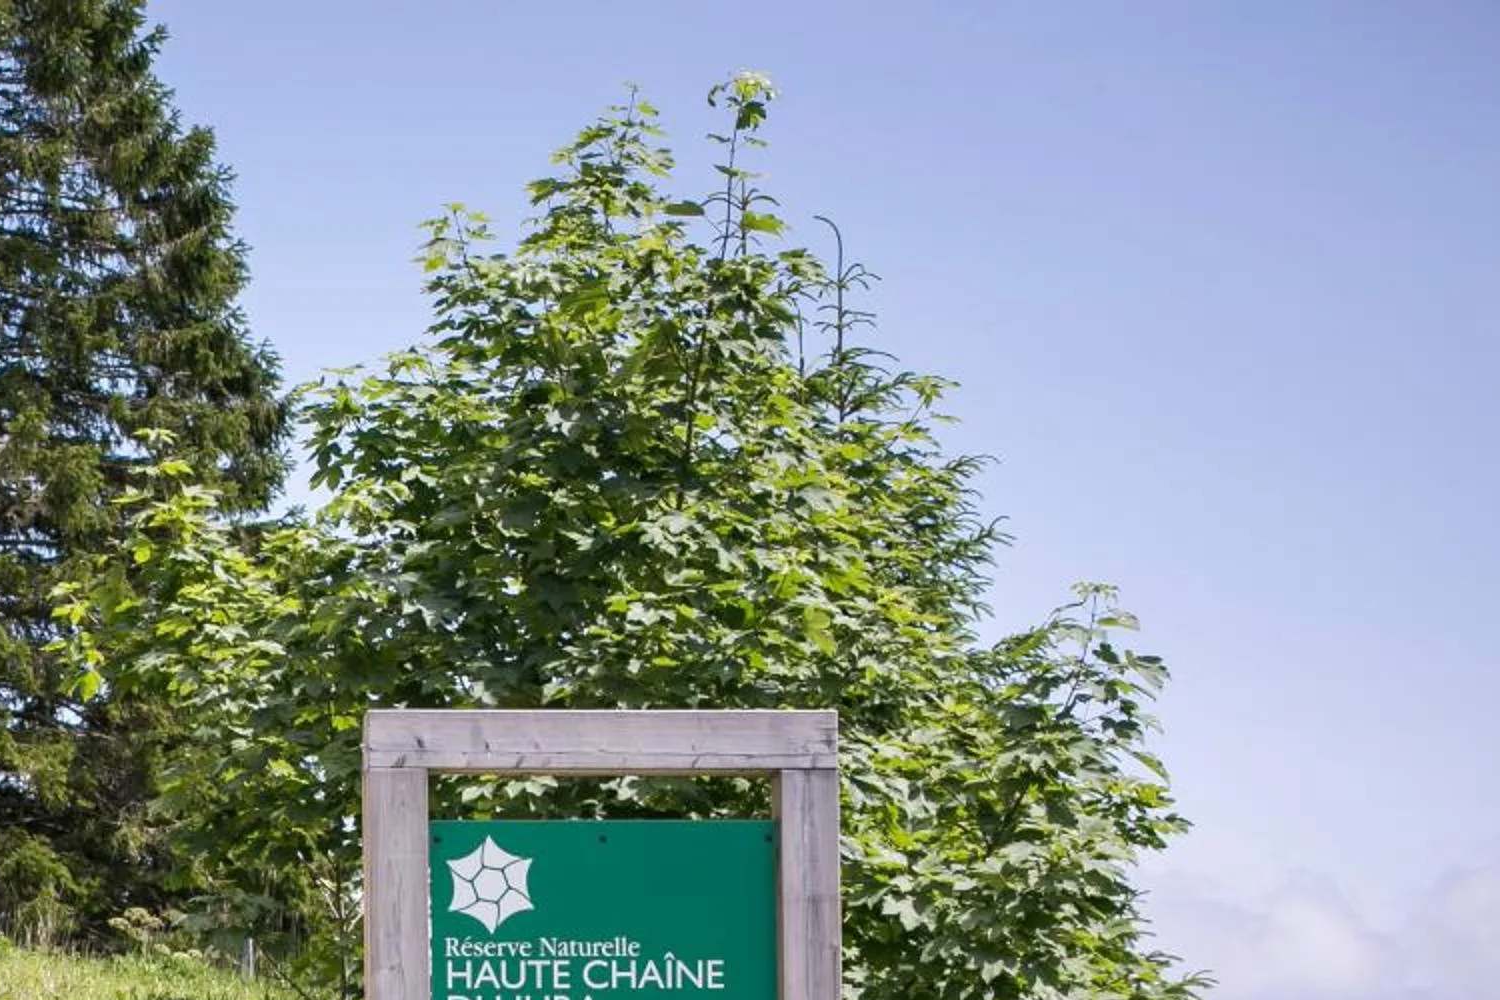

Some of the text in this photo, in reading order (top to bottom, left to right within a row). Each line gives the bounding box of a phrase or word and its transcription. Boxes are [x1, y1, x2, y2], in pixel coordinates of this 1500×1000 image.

[445, 936, 641, 957] Réserve Naturelle
[446, 951, 725, 989] HAUTE CHAÎNE
